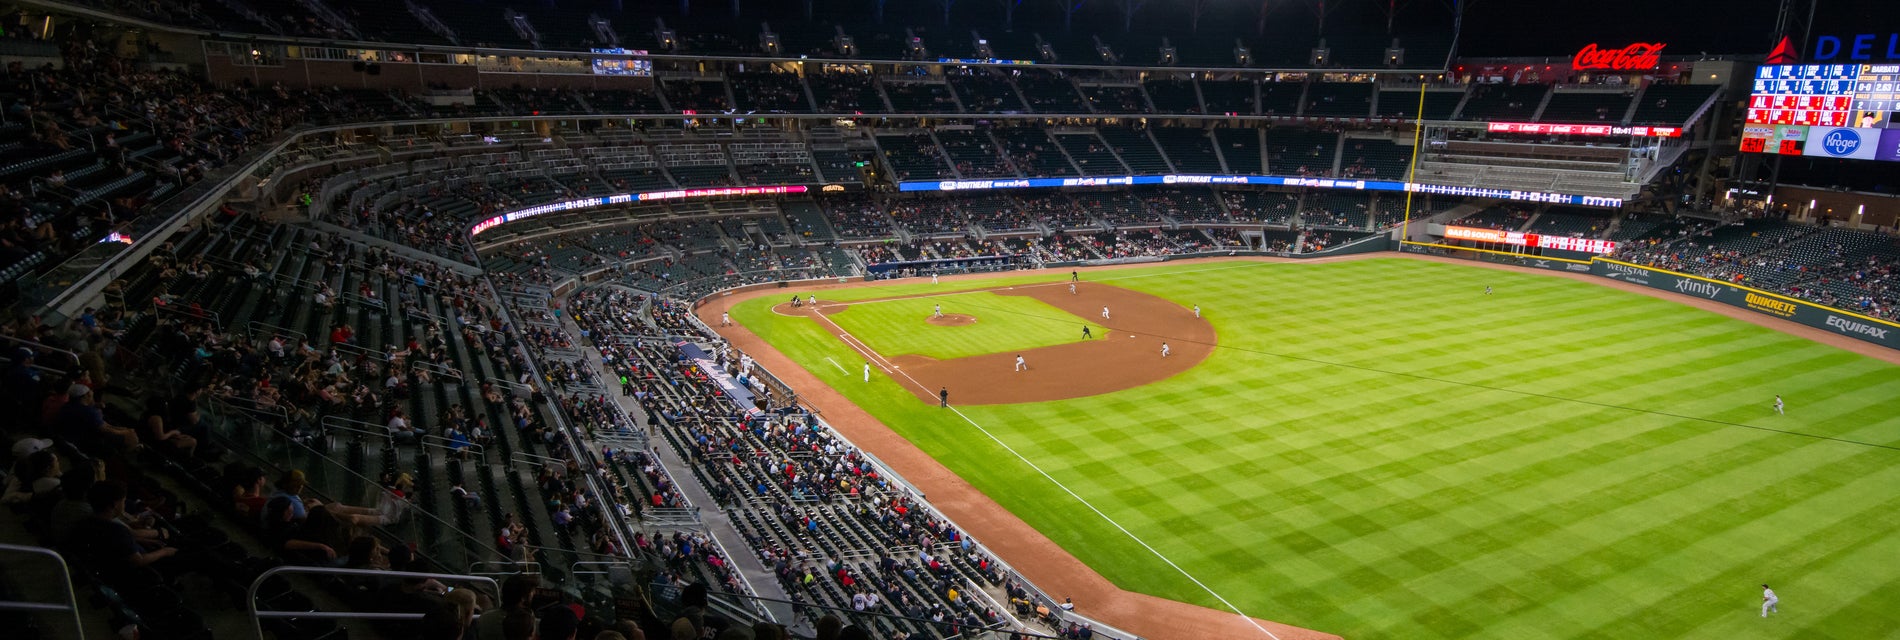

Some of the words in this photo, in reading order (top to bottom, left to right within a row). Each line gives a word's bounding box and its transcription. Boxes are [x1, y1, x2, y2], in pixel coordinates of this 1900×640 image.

[1813, 33, 1900, 60] DEL
[1572, 43, 1667, 71] Coca-Cola
[1760, 66, 1774, 79] NL
[1753, 96, 1767, 108] AL
[1826, 132, 1858, 154] Kroger
[957, 181, 993, 189] SOUTHEAST
[1177, 175, 1212, 183] SOUTHEAST
[1472, 231, 1498, 240] SOUTH
[1606, 263, 1650, 277] WELLSTAR
[1675, 278, 1721, 299] xfinity
[1745, 292, 1797, 314] QUIKRETE
[1825, 315, 1888, 339] EQUIFAX
